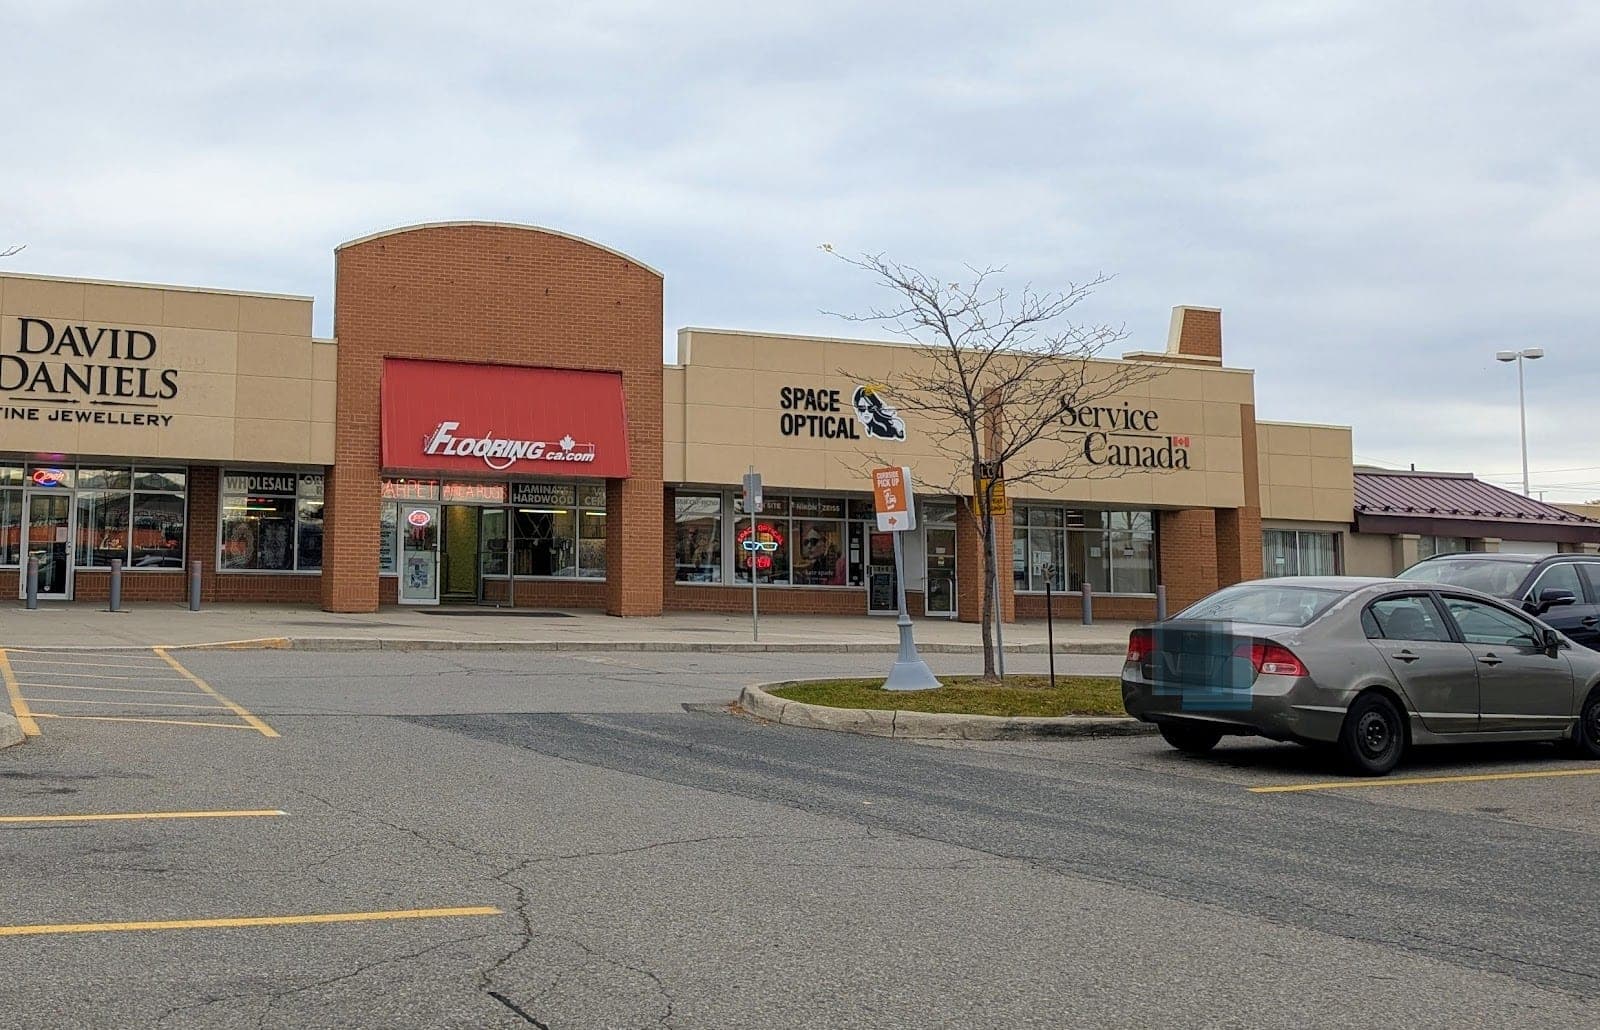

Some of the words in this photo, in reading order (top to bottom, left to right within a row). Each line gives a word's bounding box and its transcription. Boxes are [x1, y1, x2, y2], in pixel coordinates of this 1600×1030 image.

[17, 317, 157, 361] DAVID
[0, 354, 178, 399] DANIELS
[780, 386, 840, 412] SPACE
[1060, 392, 1159, 431] Service
[48, 410, 173, 427] JEWELLERY
[780, 413, 860, 439] OPTICAL
[427, 421, 545, 460] FLOORING
[1084, 431, 1190, 469] Canada
[227, 476, 294, 491] WHOLESALE
[891, 477, 900, 487] UP
[513, 493, 574, 504] HARDWOOD
